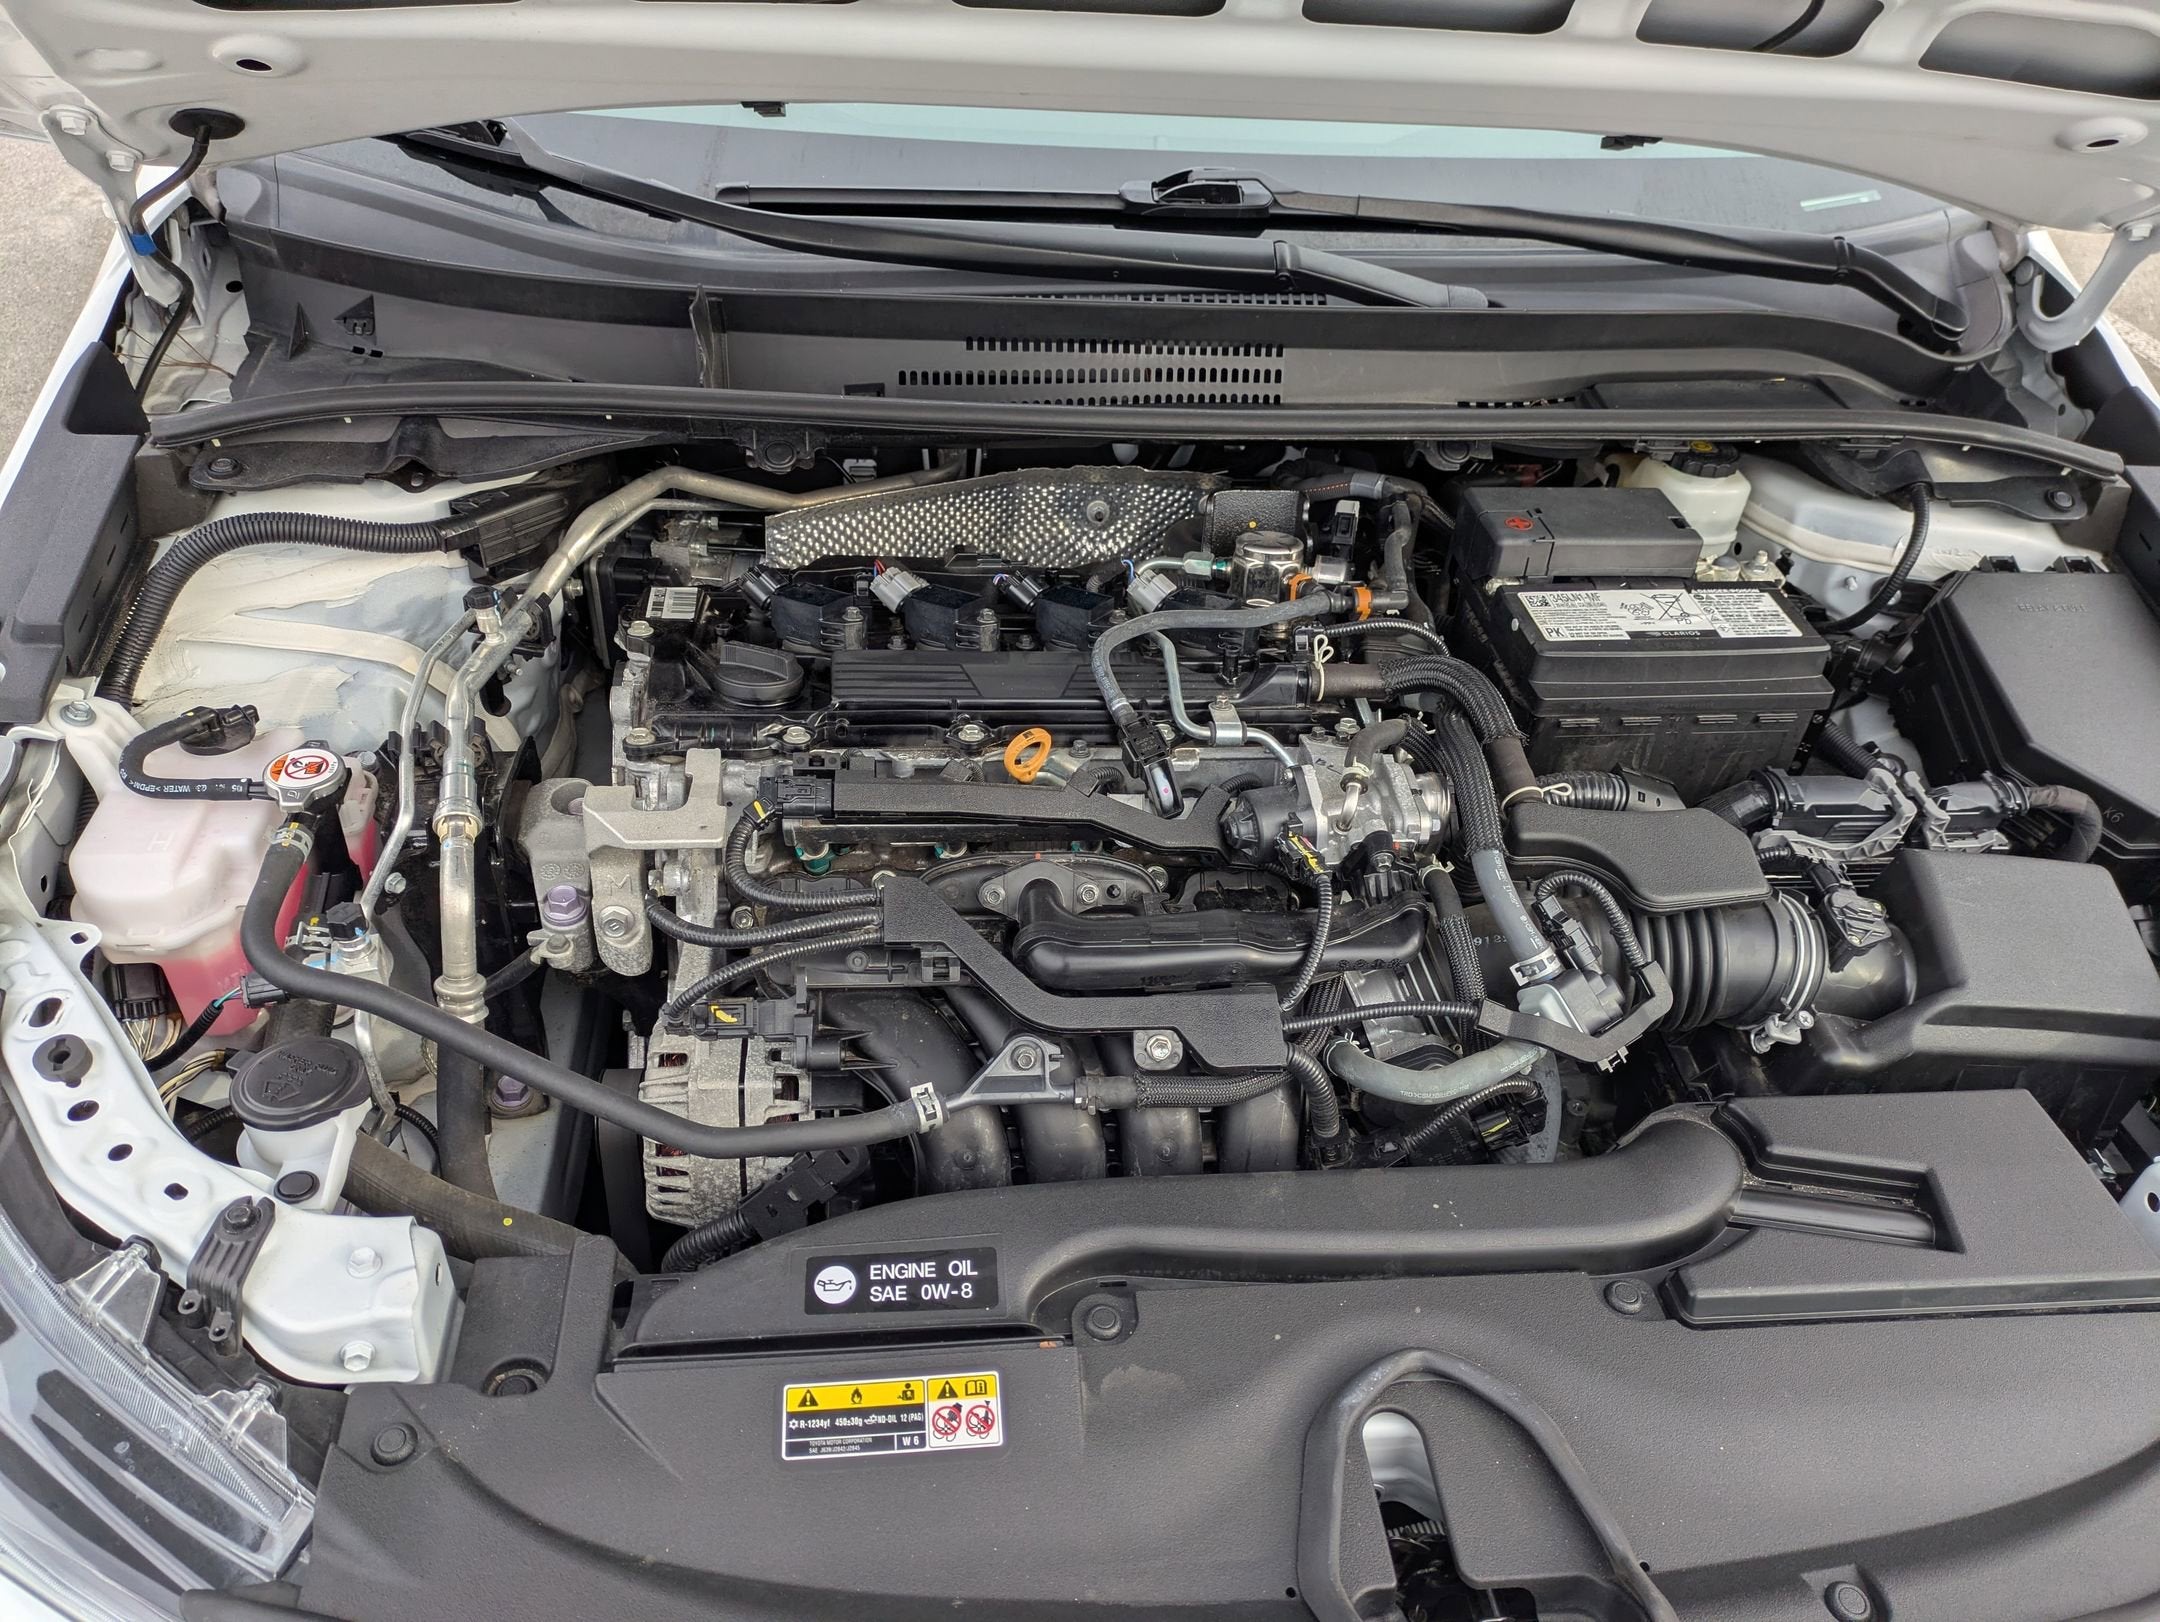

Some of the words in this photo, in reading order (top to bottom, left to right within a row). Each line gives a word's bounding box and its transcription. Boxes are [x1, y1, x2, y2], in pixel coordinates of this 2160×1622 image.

[1545, 627, 1565, 638] PK
[163, 784, 191, 793] WATER
[869, 1261, 936, 1280] ENGINE
[947, 1259, 978, 1277] OIL
[869, 1285, 907, 1302] SAE
[920, 1282, 973, 1301] 0W-8
[799, 1420, 831, 1429] R-1234yf
[834, 1417, 863, 1427] 450±30g
[877, 1414, 898, 1423] ND-OIL
[900, 1413, 908, 1422] 12
[908, 1412, 924, 1422] (PAG)
[827, 1438, 842, 1446] MOTOR
[842, 1437, 873, 1445] CORPORATION
[902, 1436, 912, 1446] W
[913, 1435, 919, 1445] 6
